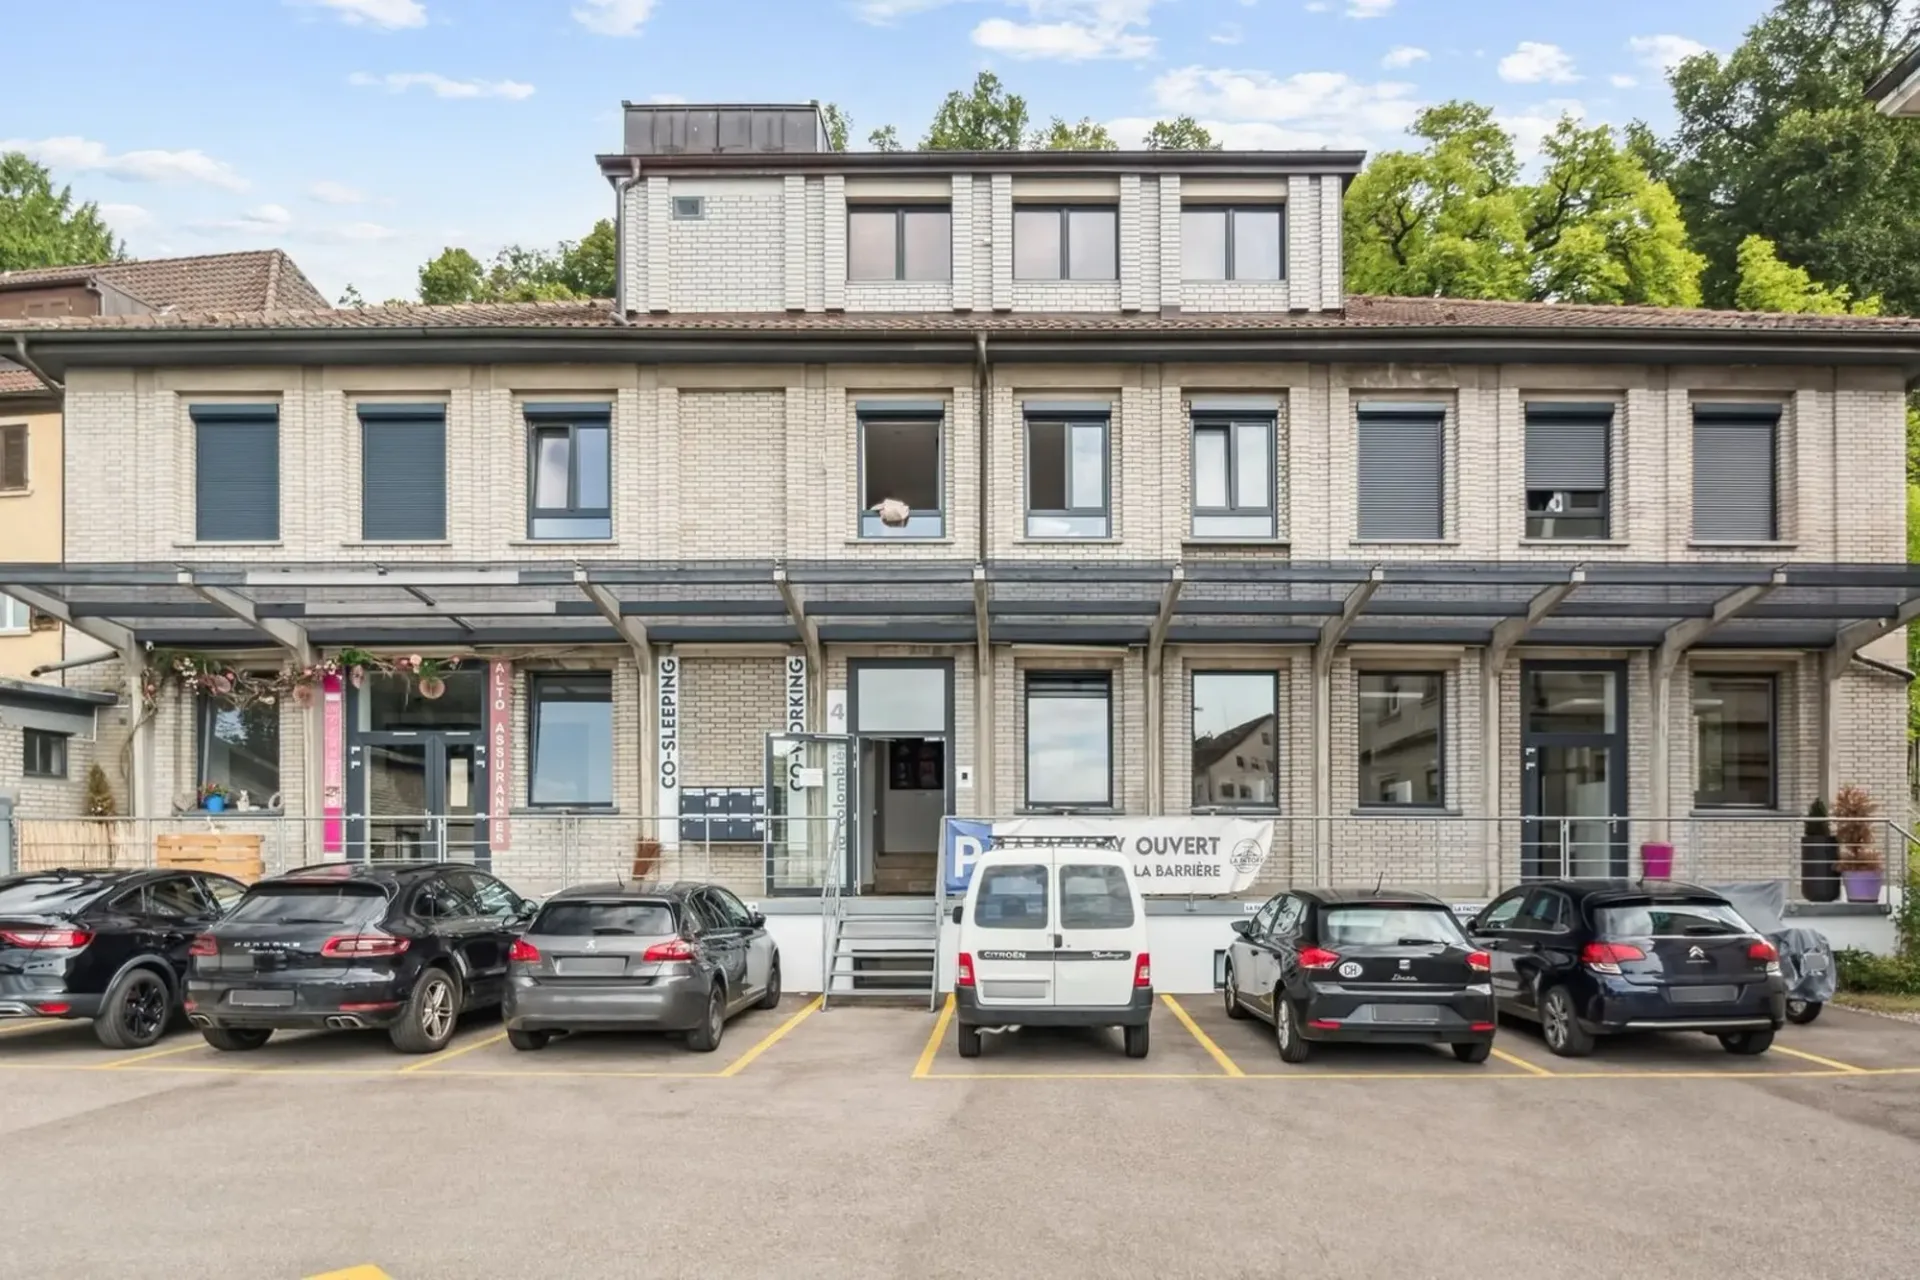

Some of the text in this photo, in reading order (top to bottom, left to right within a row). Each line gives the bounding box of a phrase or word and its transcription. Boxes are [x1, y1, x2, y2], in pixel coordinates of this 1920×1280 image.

[661, 658, 676, 789] CO-SLEEPING
[495, 662, 505, 844] ALTO ASSURANCES
[954, 835, 983, 878] P
[1135, 836, 1221, 856] OUVERT
[1133, 861, 1221, 877] LA BARRIÈRE
[1344, 965, 1357, 976] CH
